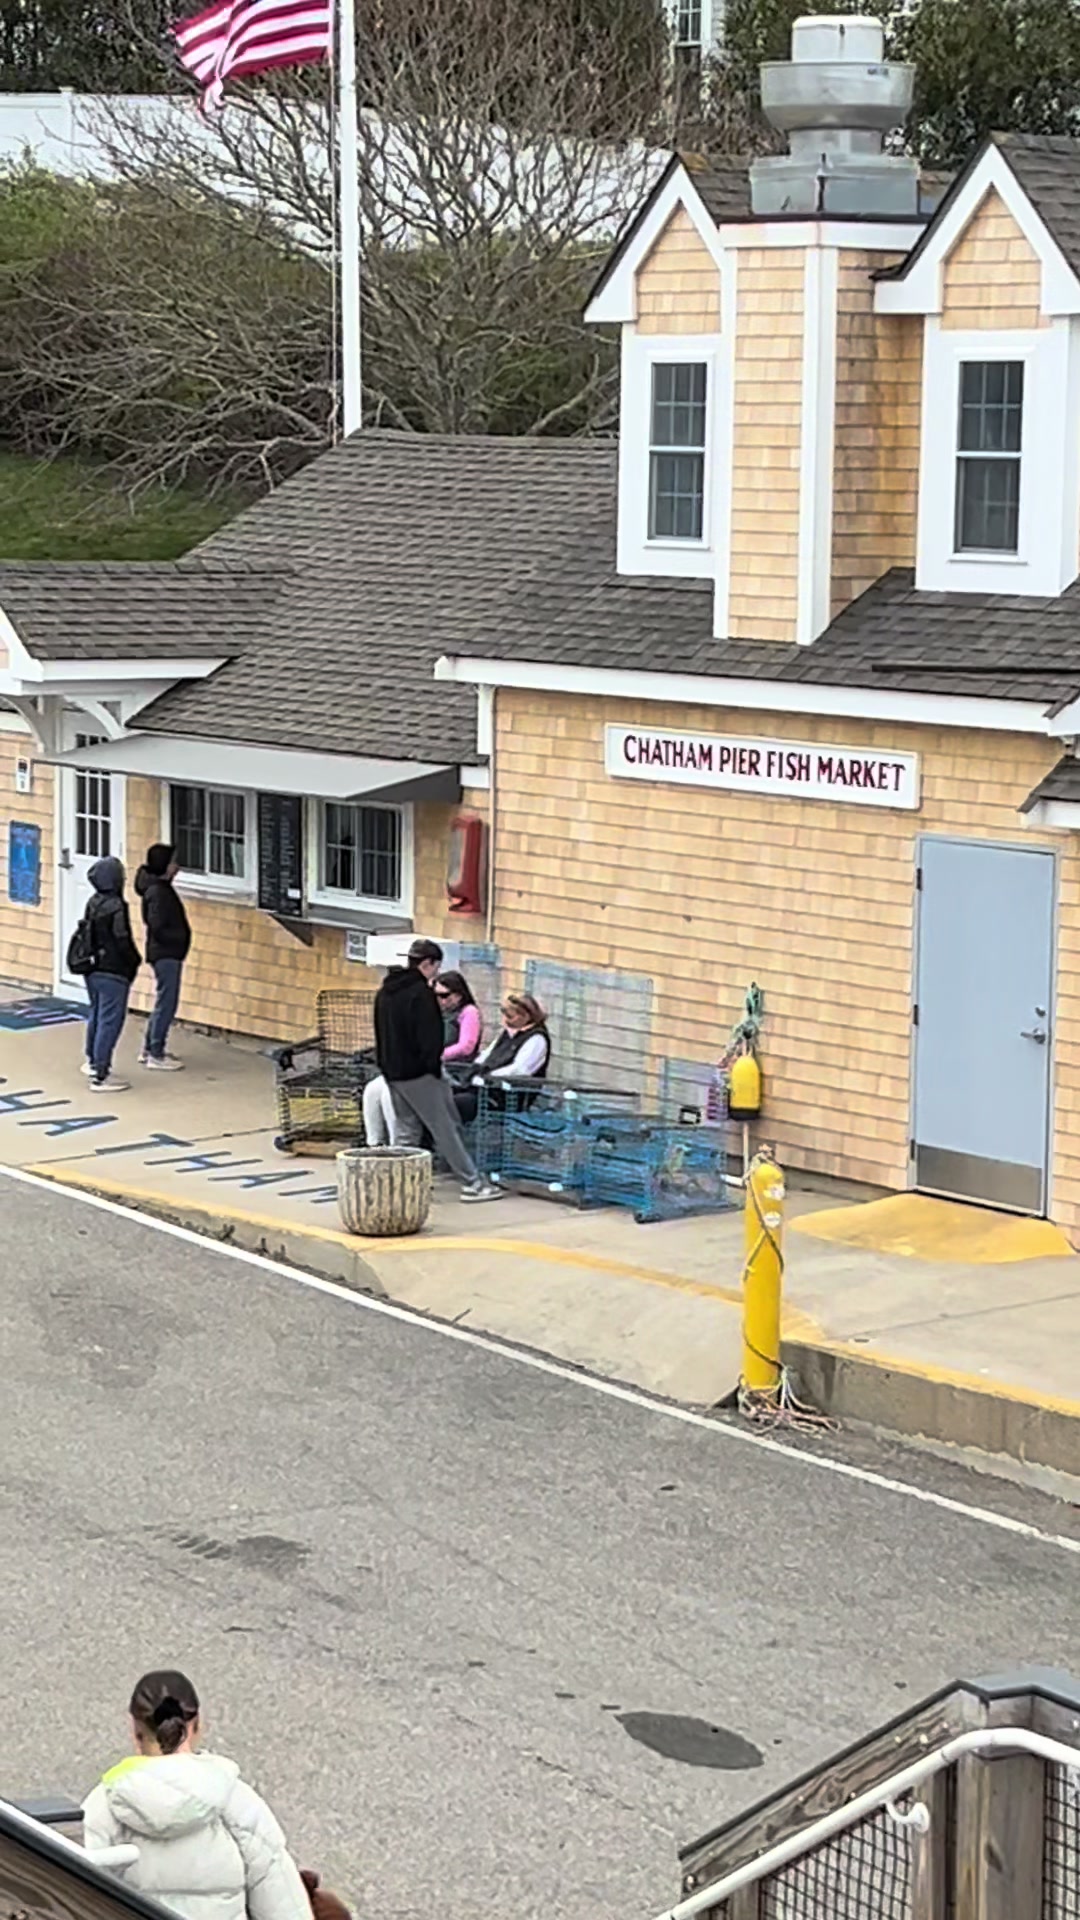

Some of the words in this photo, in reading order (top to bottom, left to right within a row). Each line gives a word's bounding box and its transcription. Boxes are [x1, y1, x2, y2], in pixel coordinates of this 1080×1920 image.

[624, 735, 713, 771] CHATHAM
[719, 746, 761, 776] PIER
[767, 751, 811, 781] FISH
[817, 756, 906, 791] MARKET
